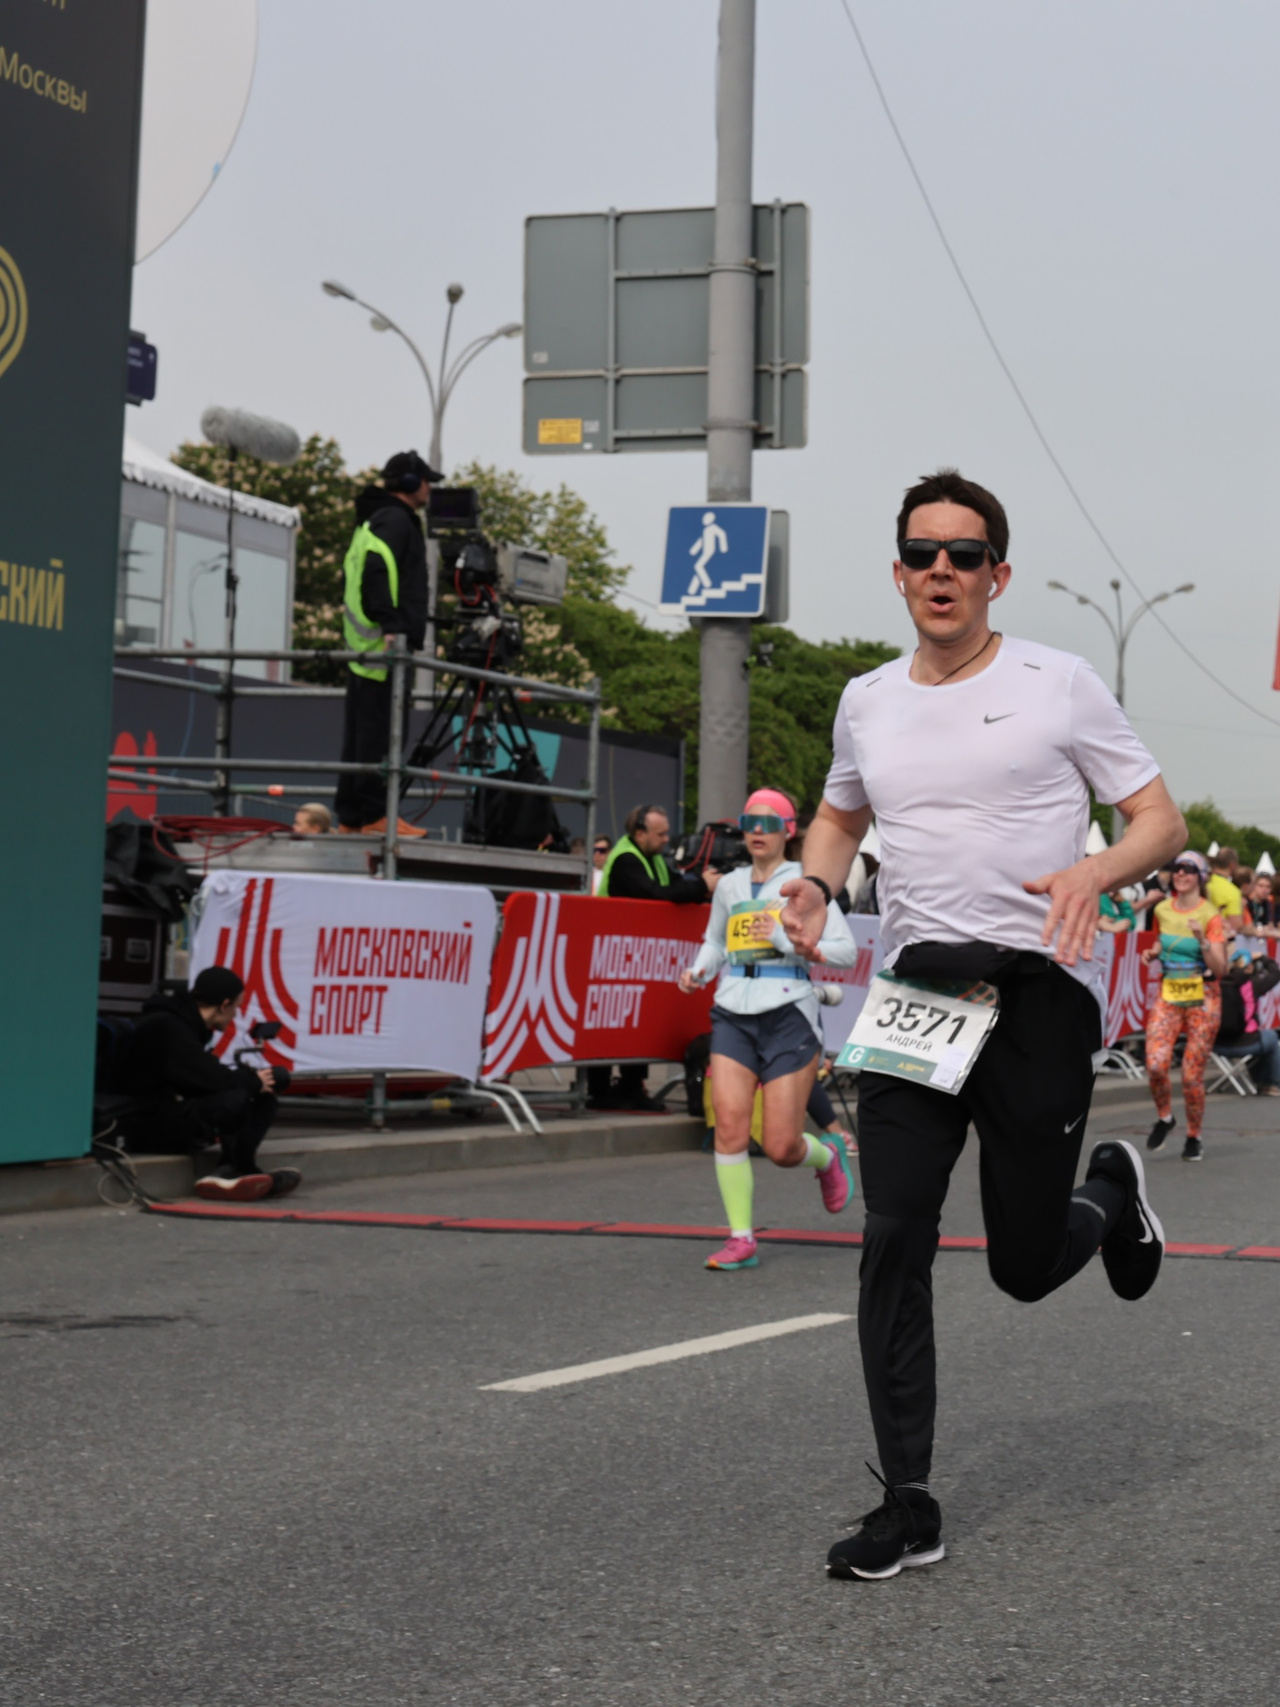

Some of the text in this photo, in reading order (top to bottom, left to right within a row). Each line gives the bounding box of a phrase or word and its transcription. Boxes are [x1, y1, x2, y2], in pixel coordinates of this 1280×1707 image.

[0, 46, 87, 113] Москвы
[313, 921, 473, 985] МОСКОВСКИЙ
[309, 984, 389, 1036] СПОРТ
[583, 983, 646, 1030] СПОРТ
[876, 997, 968, 1045] 3571
[848, 1047, 865, 1064] G
[885, 1033, 933, 1053] АНДРЕЙ
